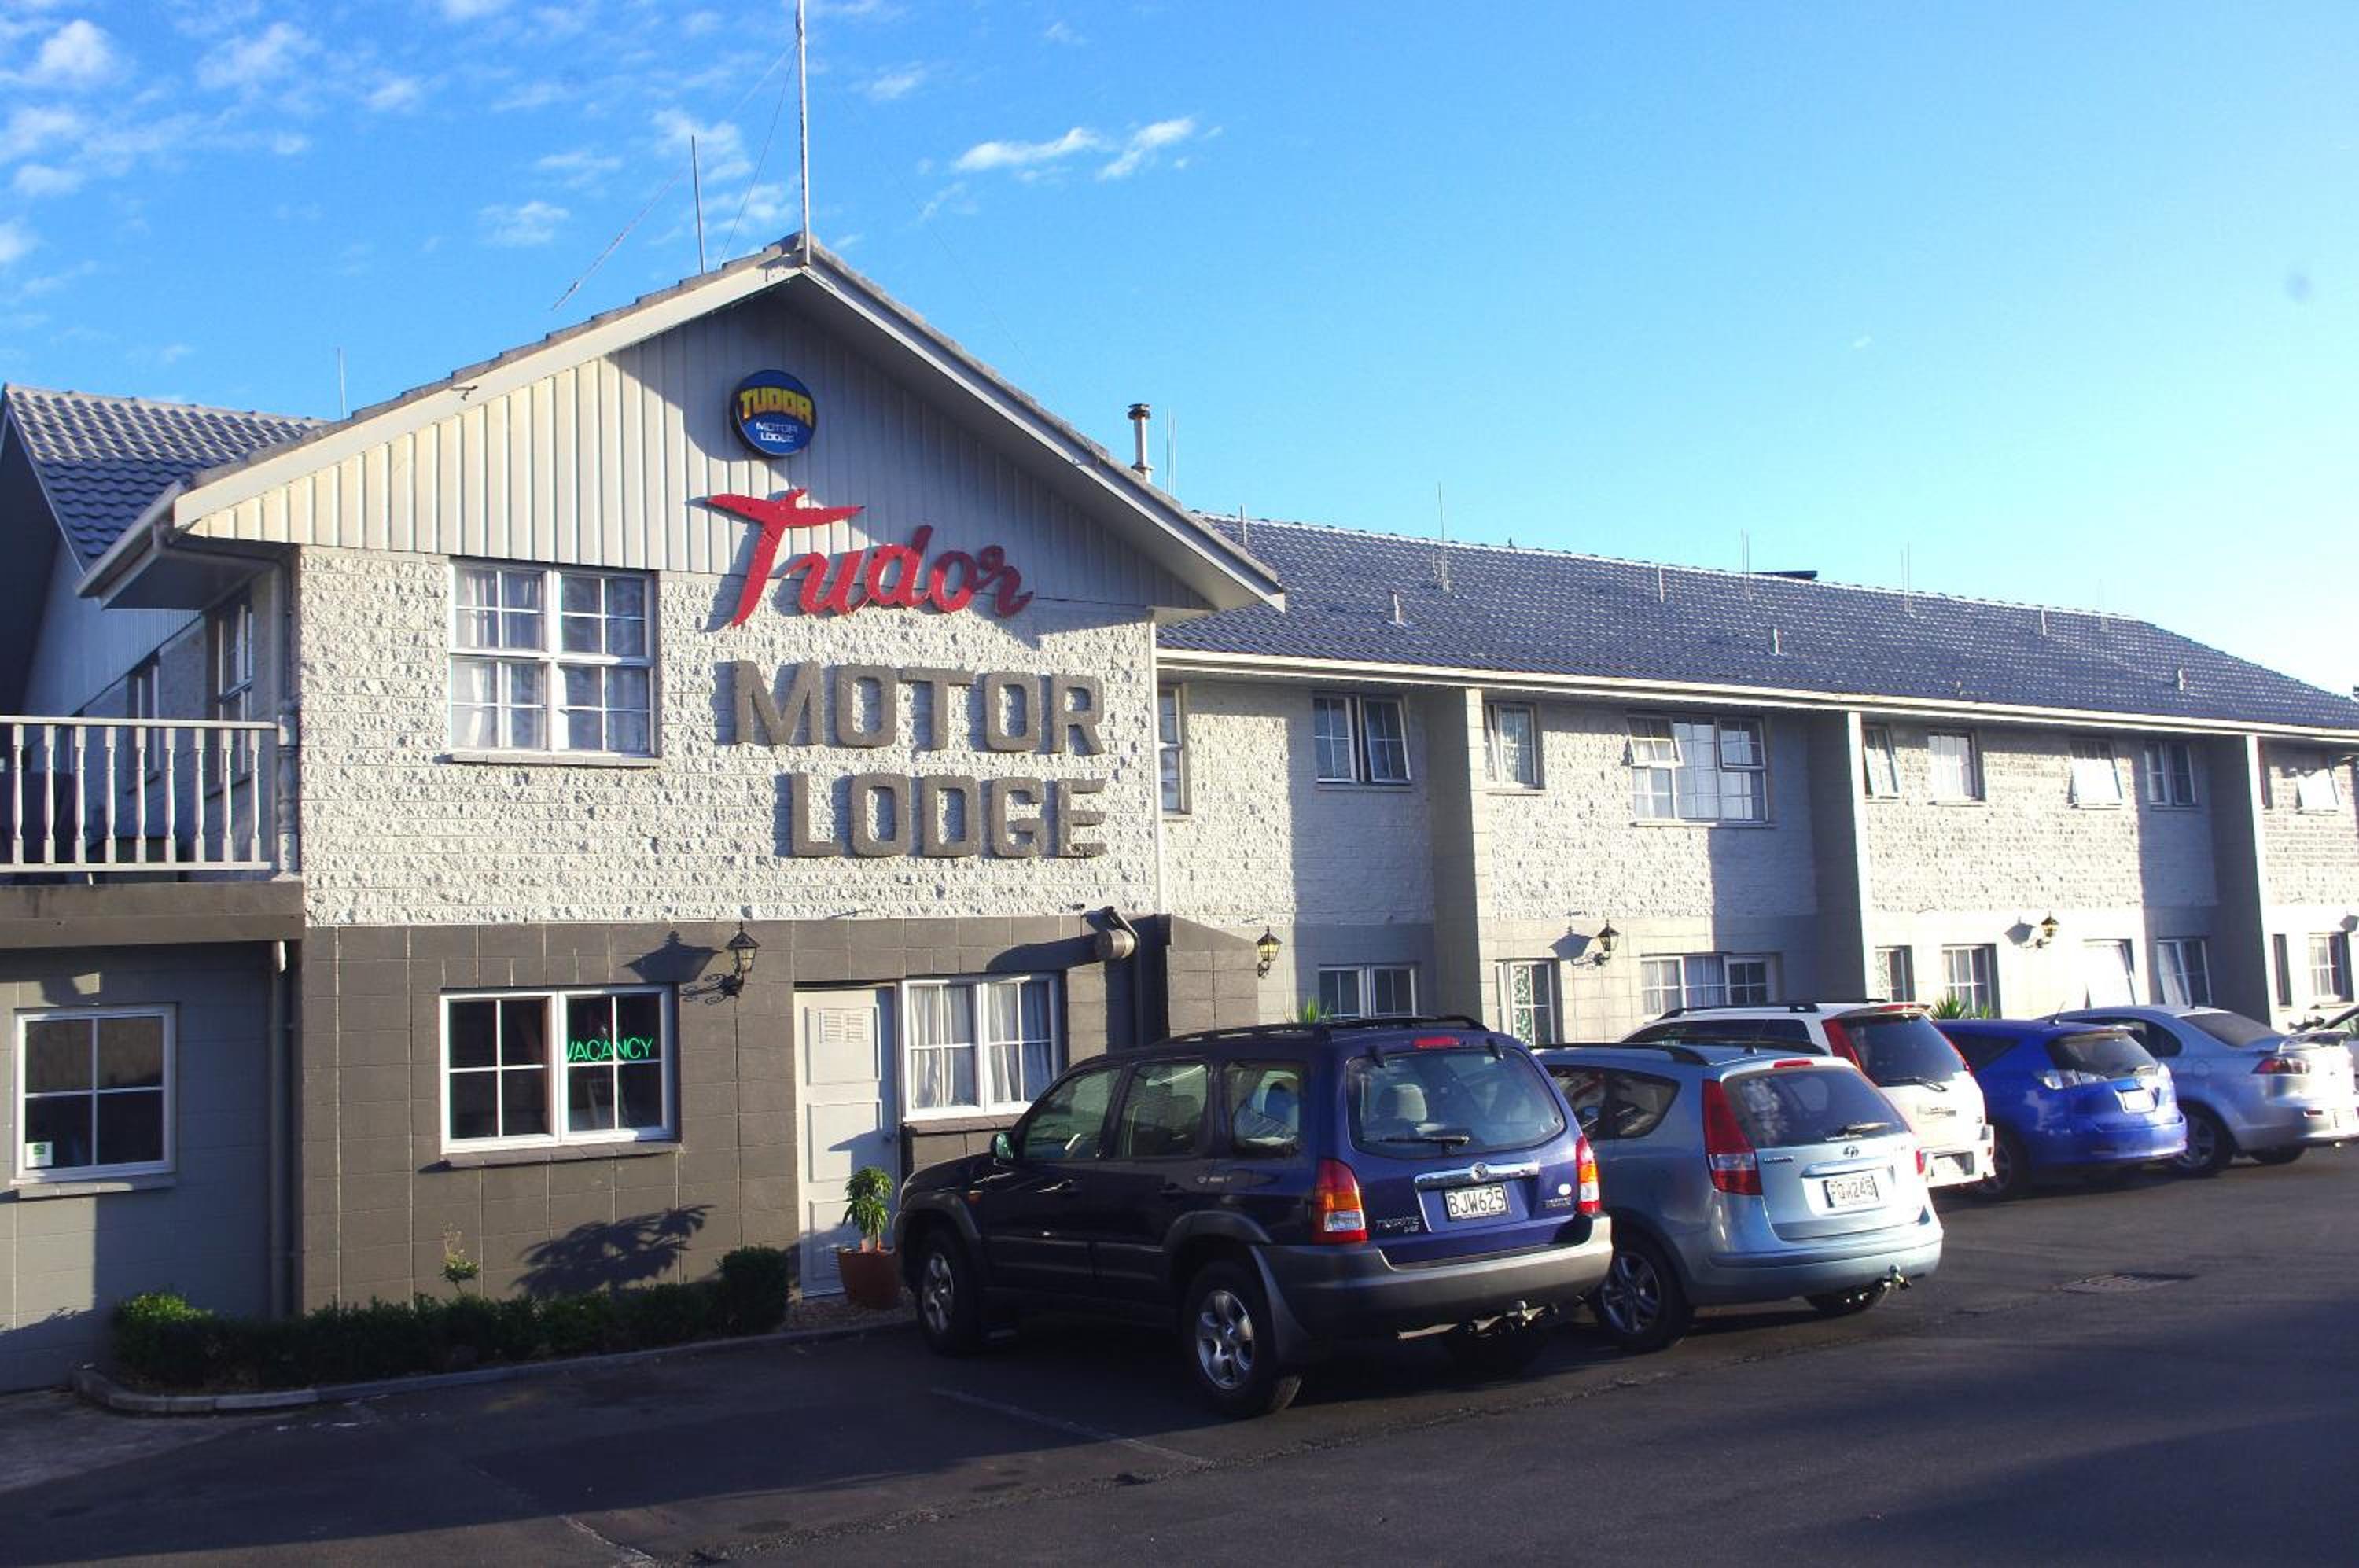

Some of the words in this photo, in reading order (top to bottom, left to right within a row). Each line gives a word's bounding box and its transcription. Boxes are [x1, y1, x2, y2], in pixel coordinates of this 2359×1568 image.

[739, 386, 813, 429] TUDOR
[756, 421, 798, 433] MOTOR
[760, 432, 795, 443] LODGE
[705, 488, 1036, 628] Tudor
[733, 659, 1106, 756] MOTOR
[789, 771, 1107, 859] LODGE
[566, 1037, 653, 1062] VACANCY
[1448, 1190, 1505, 1215] BJW625
